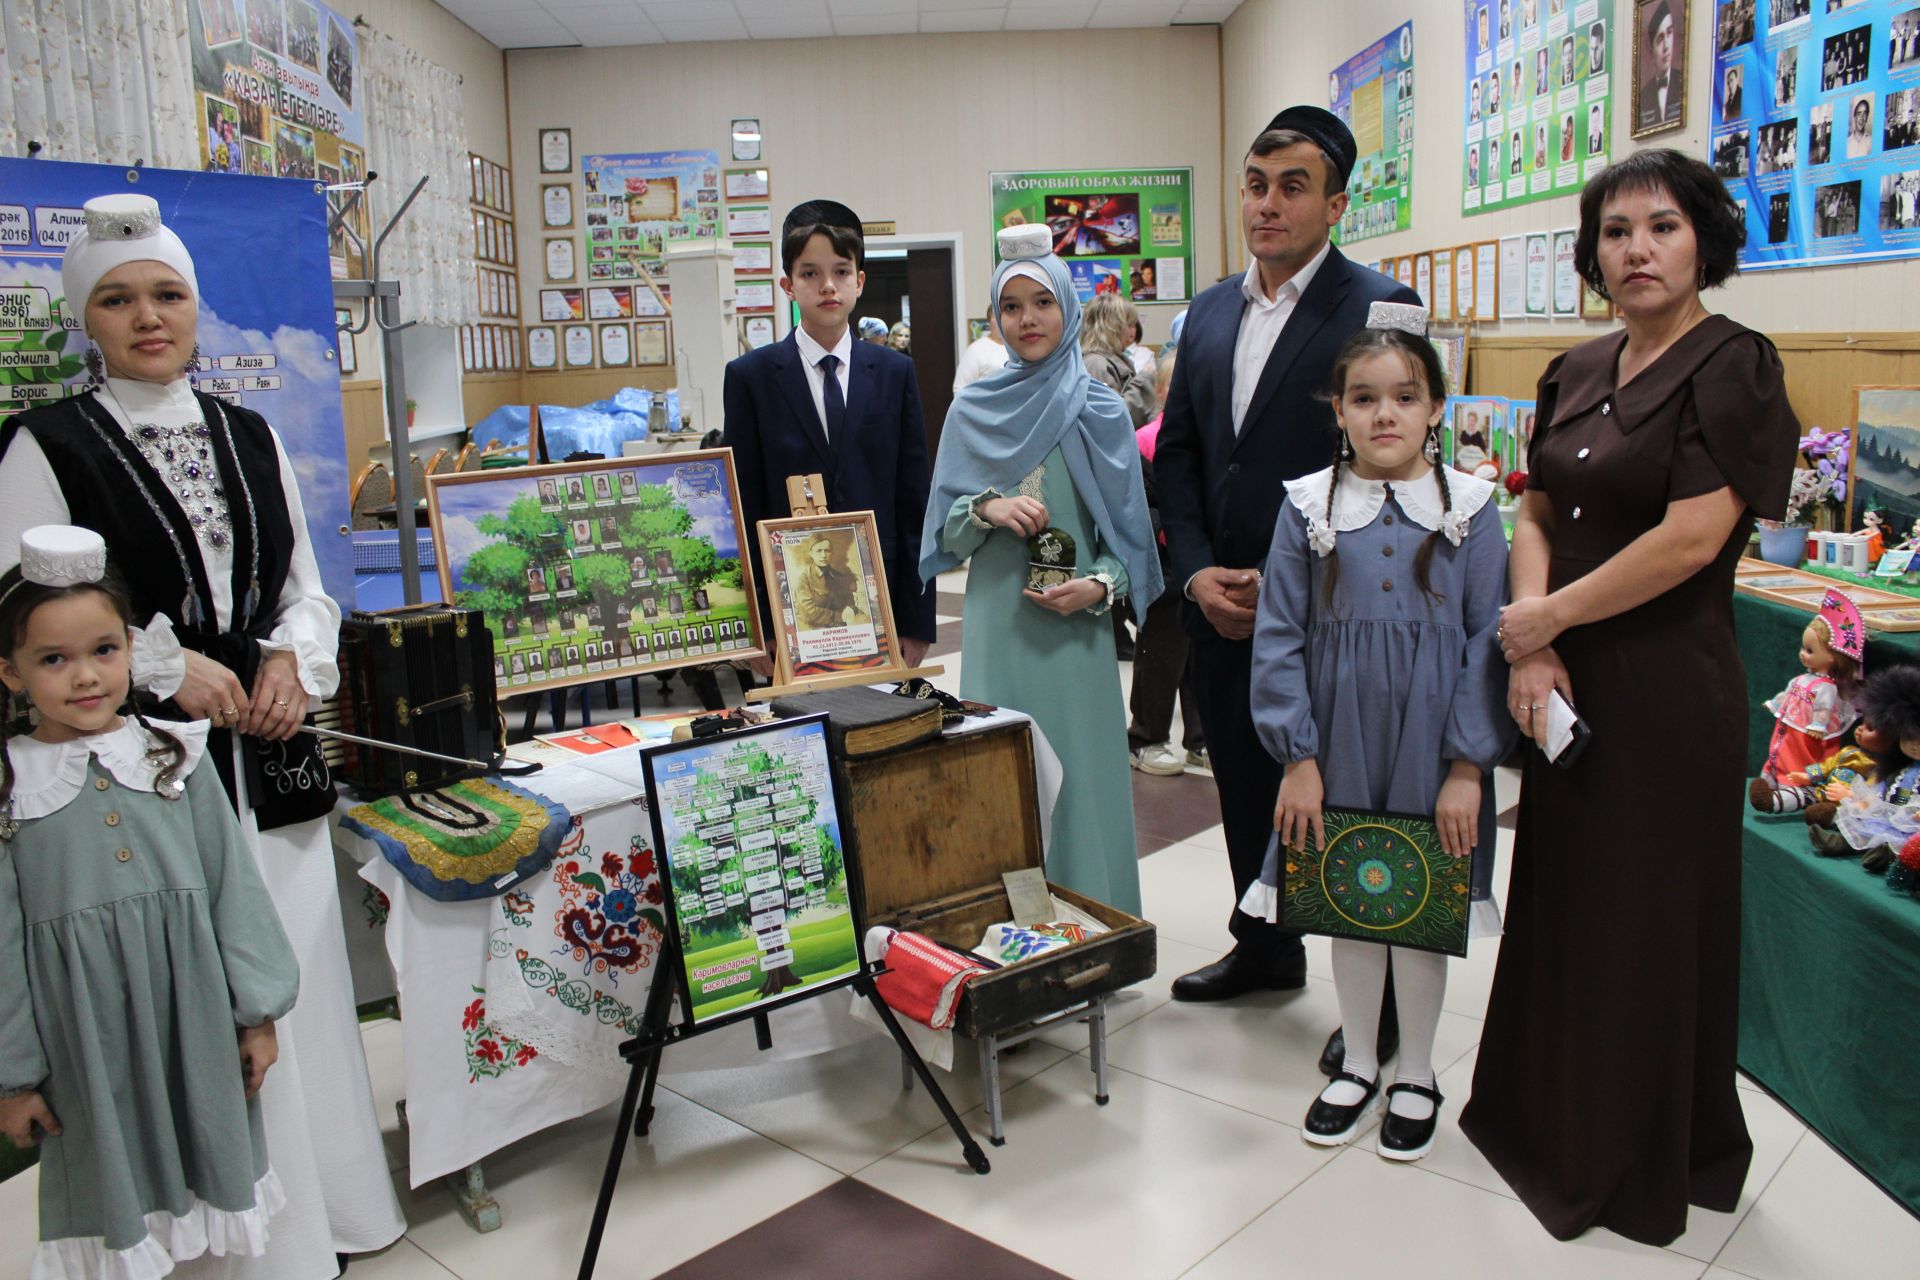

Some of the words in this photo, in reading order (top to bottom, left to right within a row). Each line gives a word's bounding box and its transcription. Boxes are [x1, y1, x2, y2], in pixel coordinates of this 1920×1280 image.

[1001, 176, 1080, 191] ЗДОРОВЫЙ
[1083, 176, 1126, 188] ОБРАЗ
[1129, 174, 1182, 187] ЖИЗНИ
[39, 230, 70, 243] (04.01
[0, 352, 50, 366] юдмила
[236, 357, 263, 368] Азизә
[11, 387, 48, 399] Борис
[823, 628, 848, 636] КАРИМОВ
